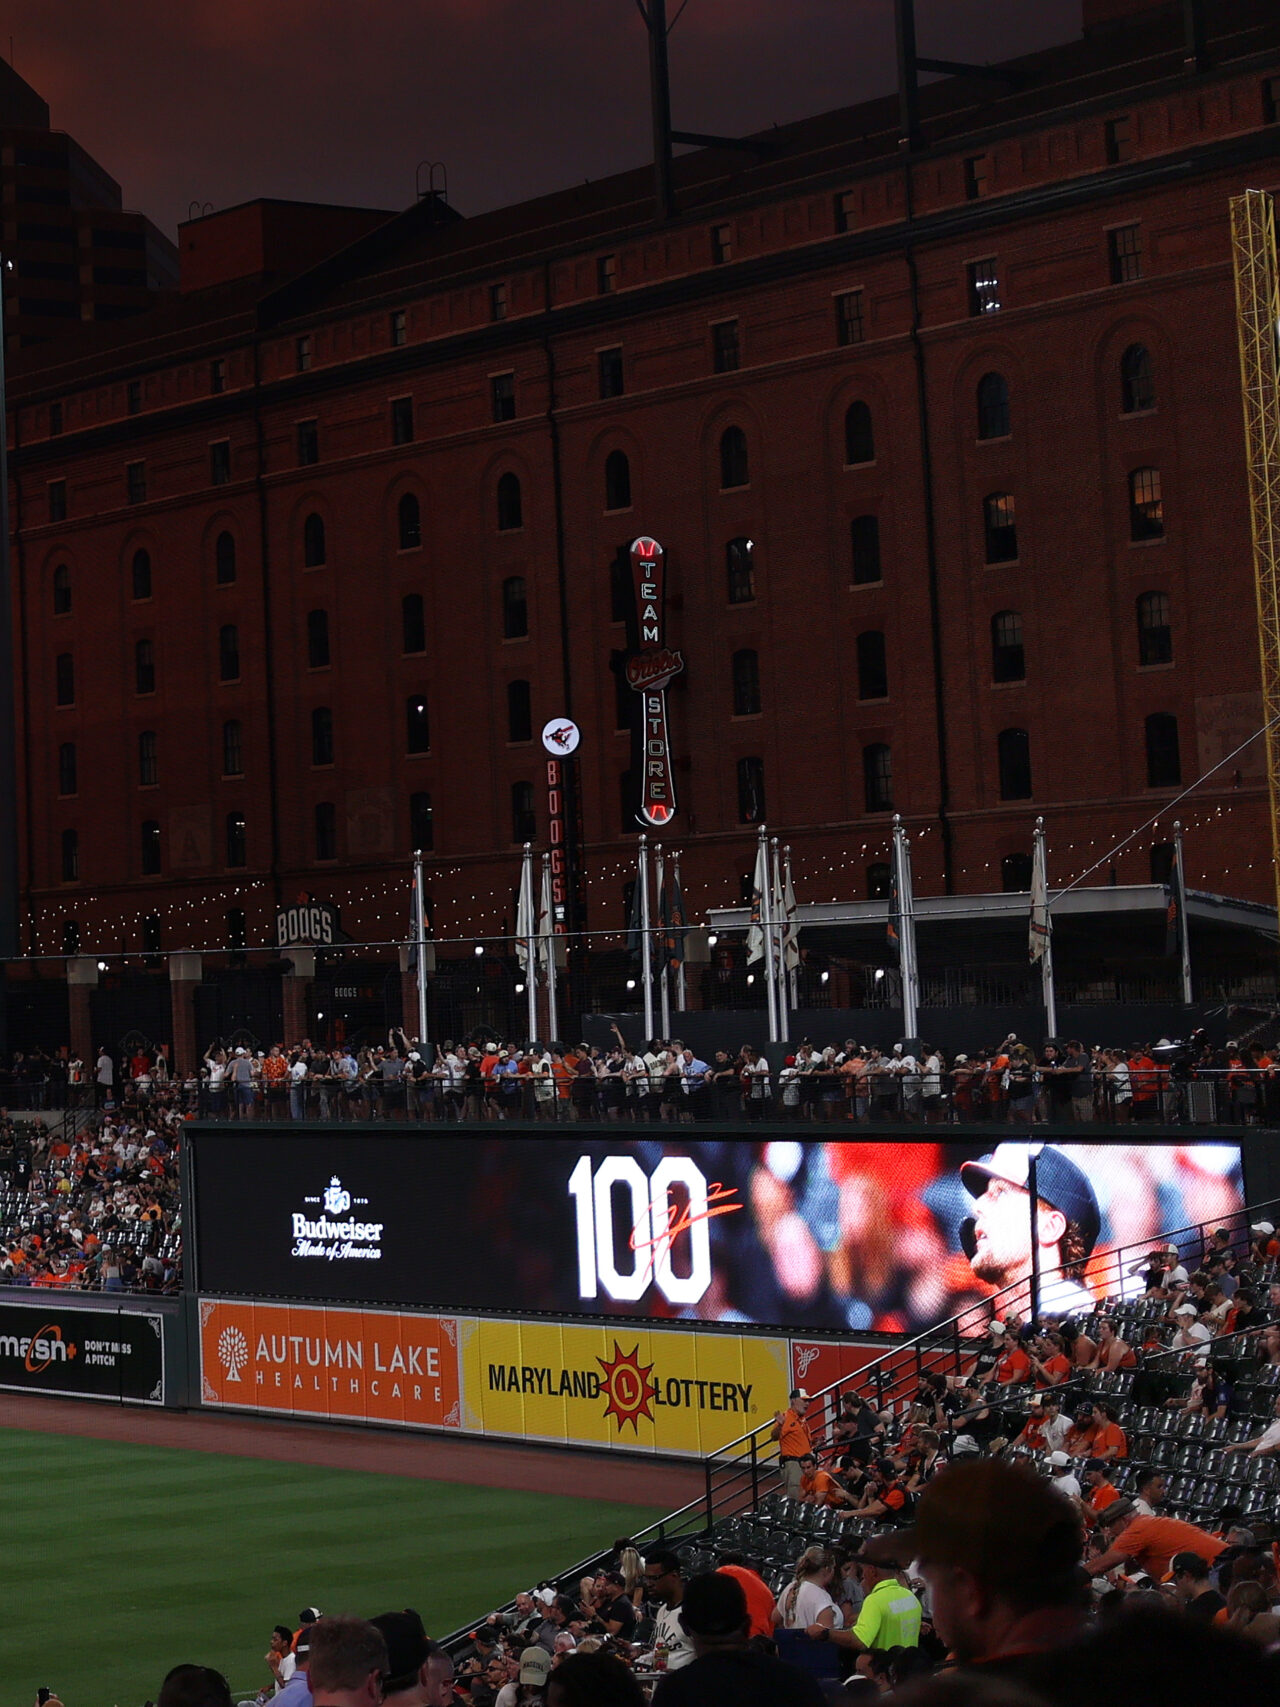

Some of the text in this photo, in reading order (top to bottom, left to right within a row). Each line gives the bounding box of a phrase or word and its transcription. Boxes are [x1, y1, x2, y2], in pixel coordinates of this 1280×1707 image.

[640, 562, 658, 641] TEAM
[648, 697, 666, 799] STORE
[292, 1213, 383, 1241] Budweiser
[569, 1155, 711, 1303] 100
[292, 1238, 381, 1261] Made of America
[85, 1340, 110, 1353] DON'T
[85, 1354, 115, 1366] A PITCH
[256, 1334, 440, 1377] AUTUMN LAKE
[256, 1371, 441, 1402] HEALTHCARE
[488, 1364, 601, 1399] MARYLAND
[654, 1377, 753, 1413] LOTTERY
